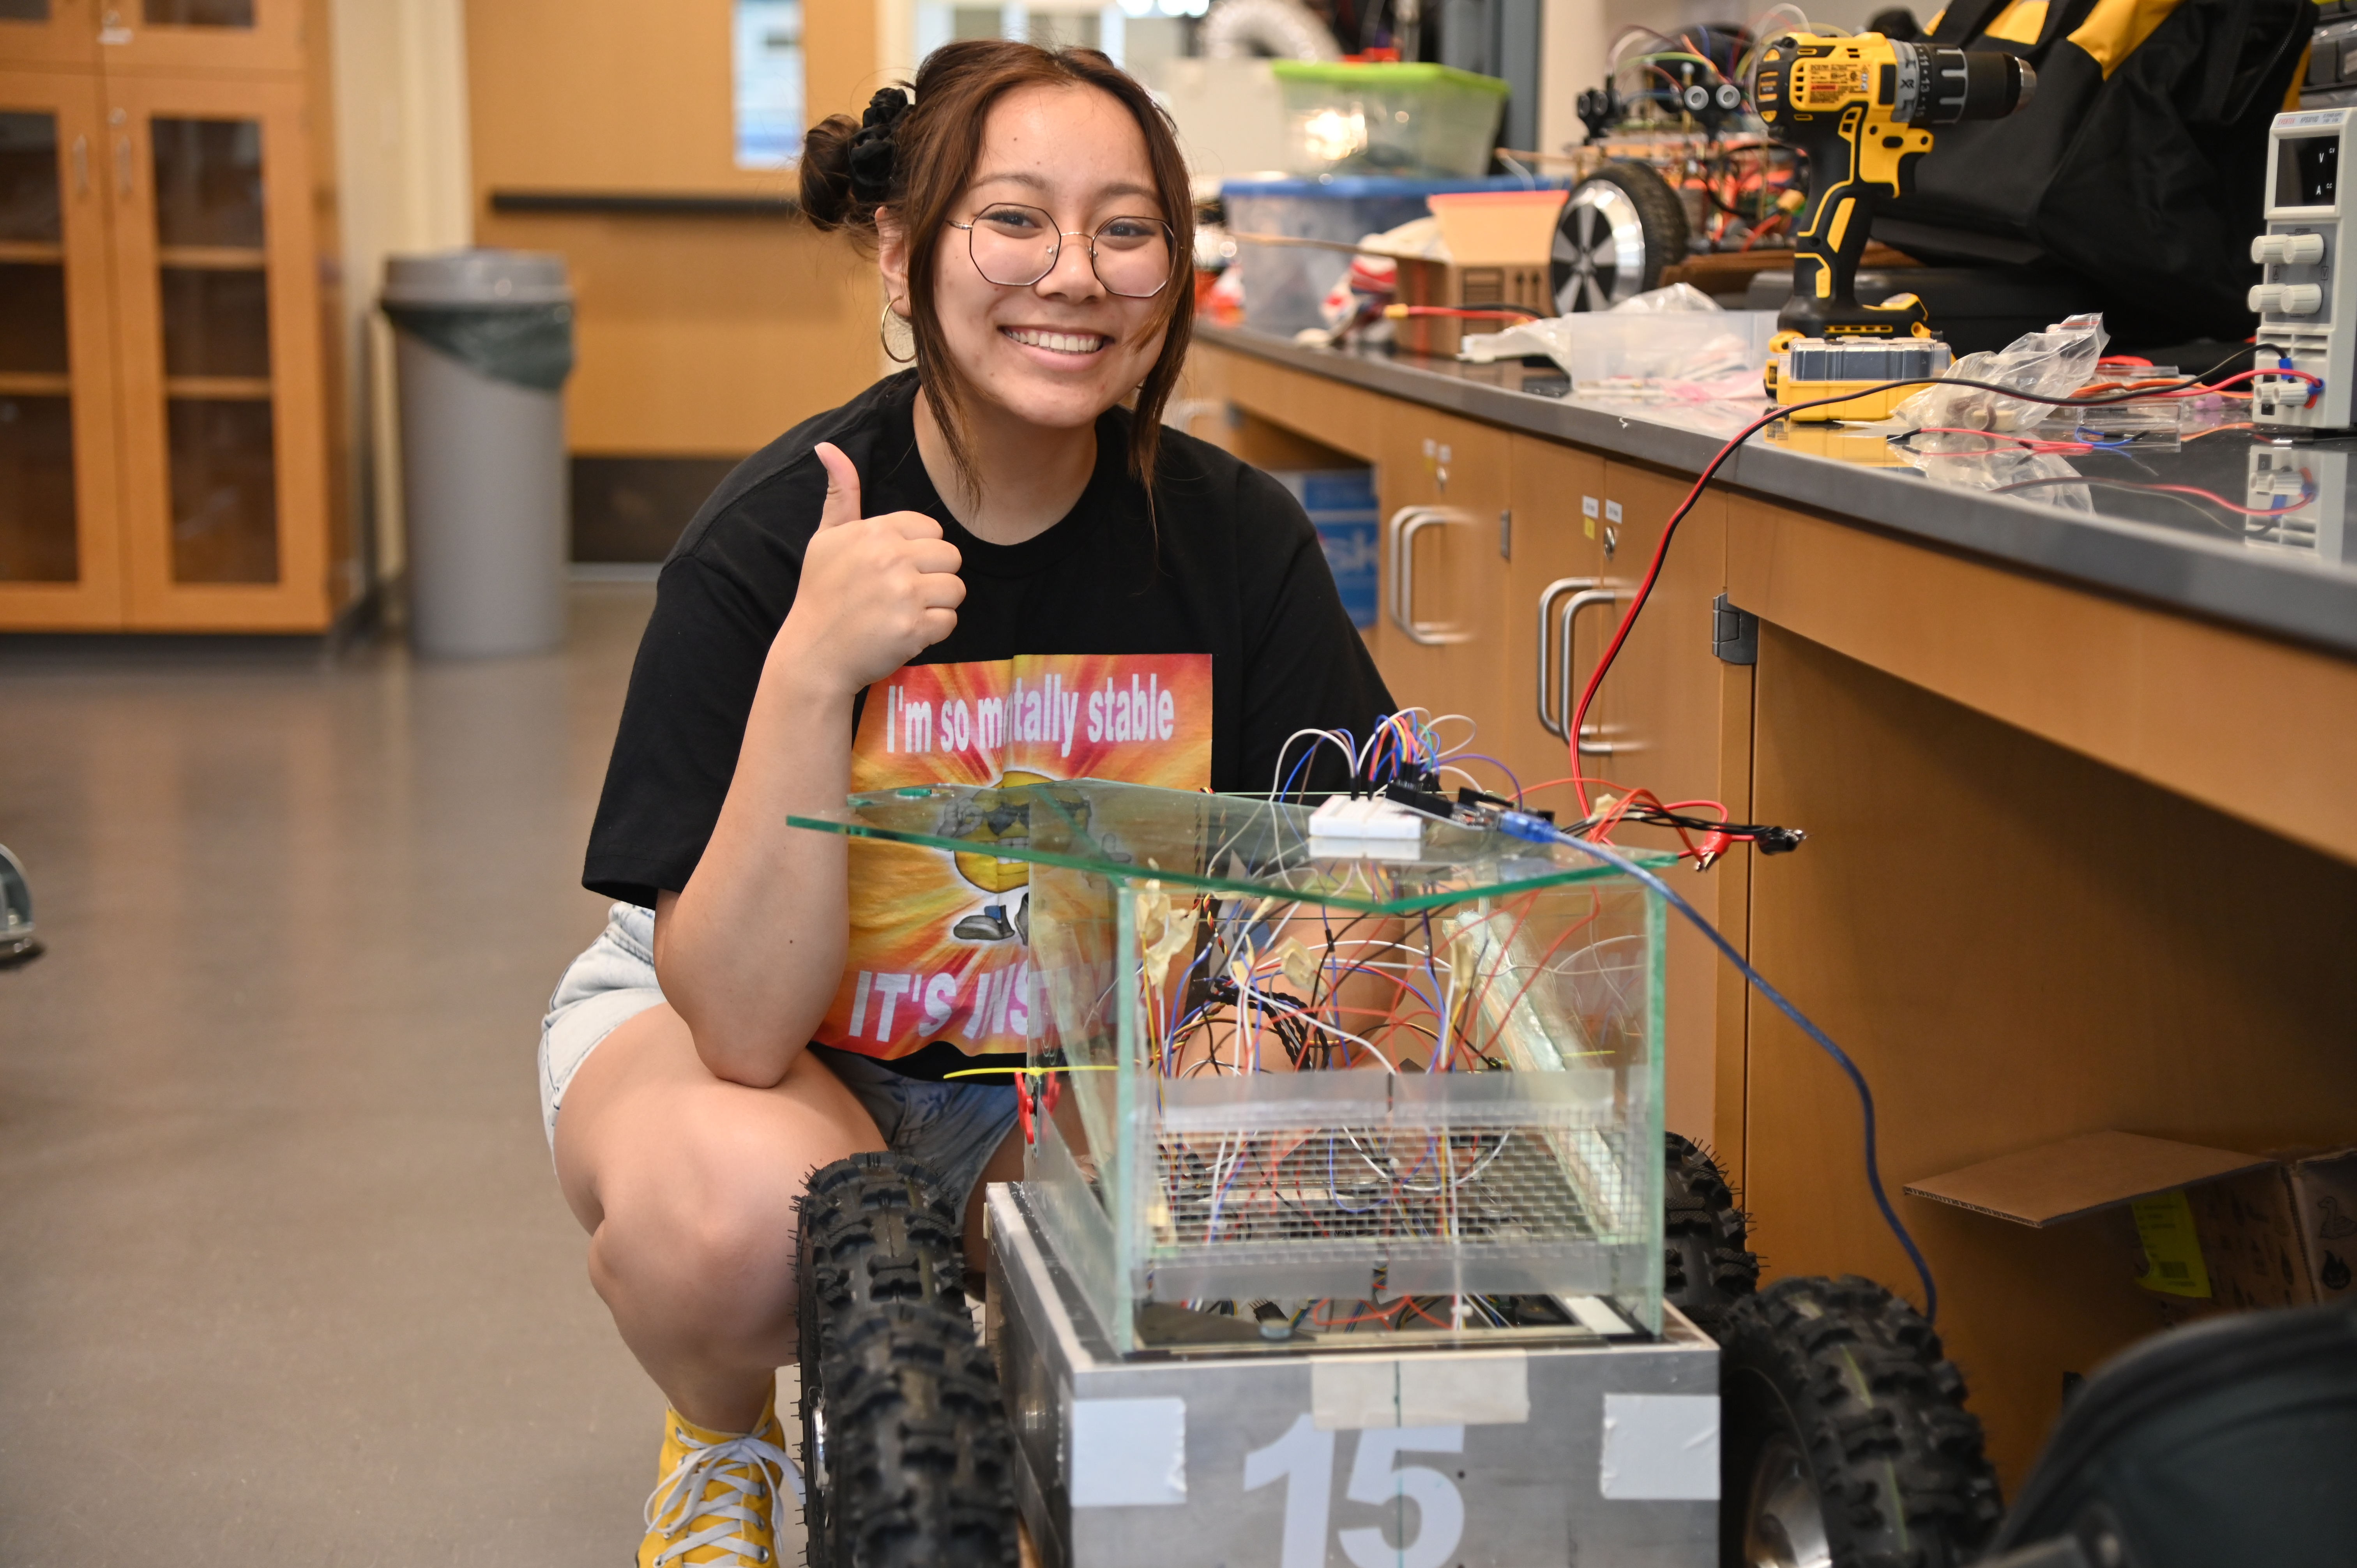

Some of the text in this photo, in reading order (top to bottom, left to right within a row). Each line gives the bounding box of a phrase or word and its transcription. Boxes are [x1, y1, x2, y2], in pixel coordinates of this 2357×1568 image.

[1899, 79, 1915, 89] XR
[2319, 152, 2324, 163] V
[2316, 185, 2321, 195] A
[887, 685, 932, 753] I'm
[940, 699, 970, 752] so
[1088, 673, 1174, 743] stable
[848, 970, 957, 1042] IT'S
[1243, 1413, 1465, 1568] 15
